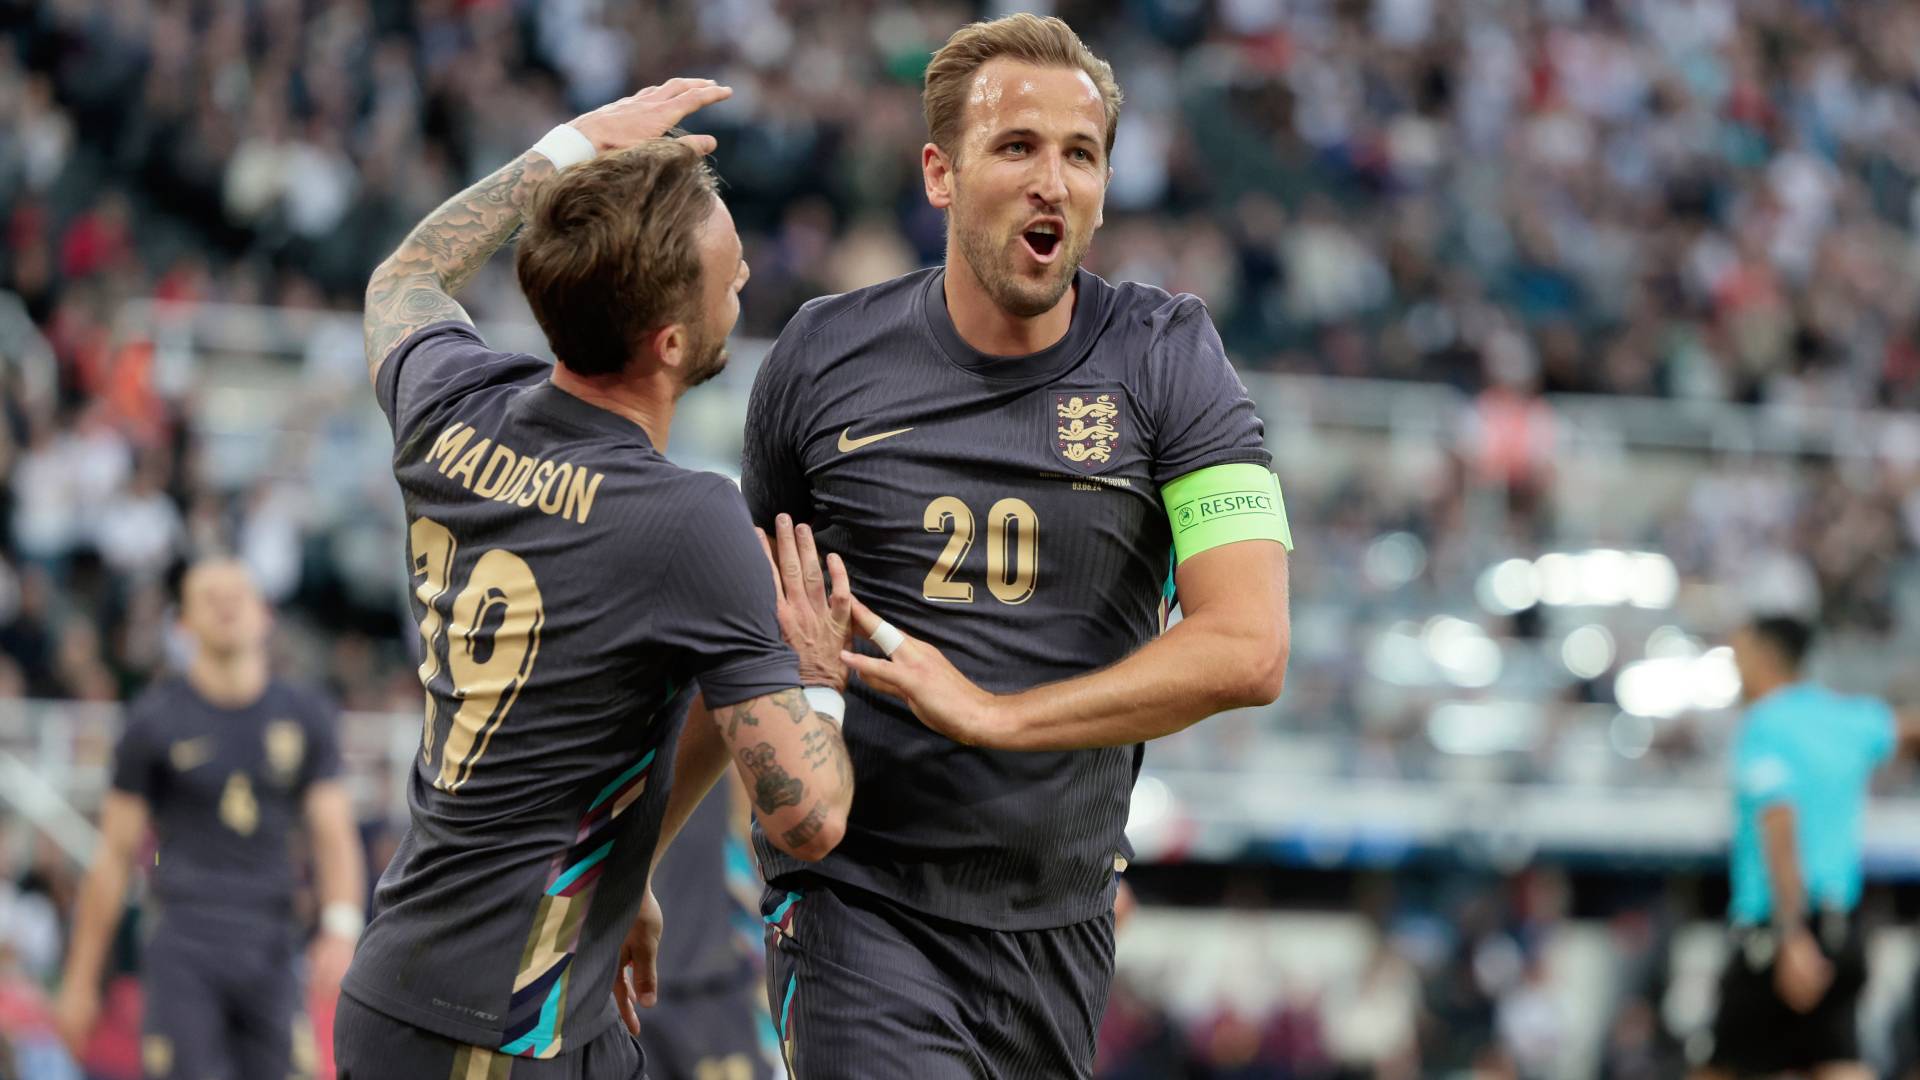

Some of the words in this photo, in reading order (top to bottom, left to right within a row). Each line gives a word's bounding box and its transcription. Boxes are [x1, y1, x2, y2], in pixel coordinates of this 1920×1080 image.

[425, 422, 605, 524] MADDISON
[1200, 495, 1273, 517] RESPECT
[923, 496, 1039, 605] 20
[411, 516, 545, 796] 19
